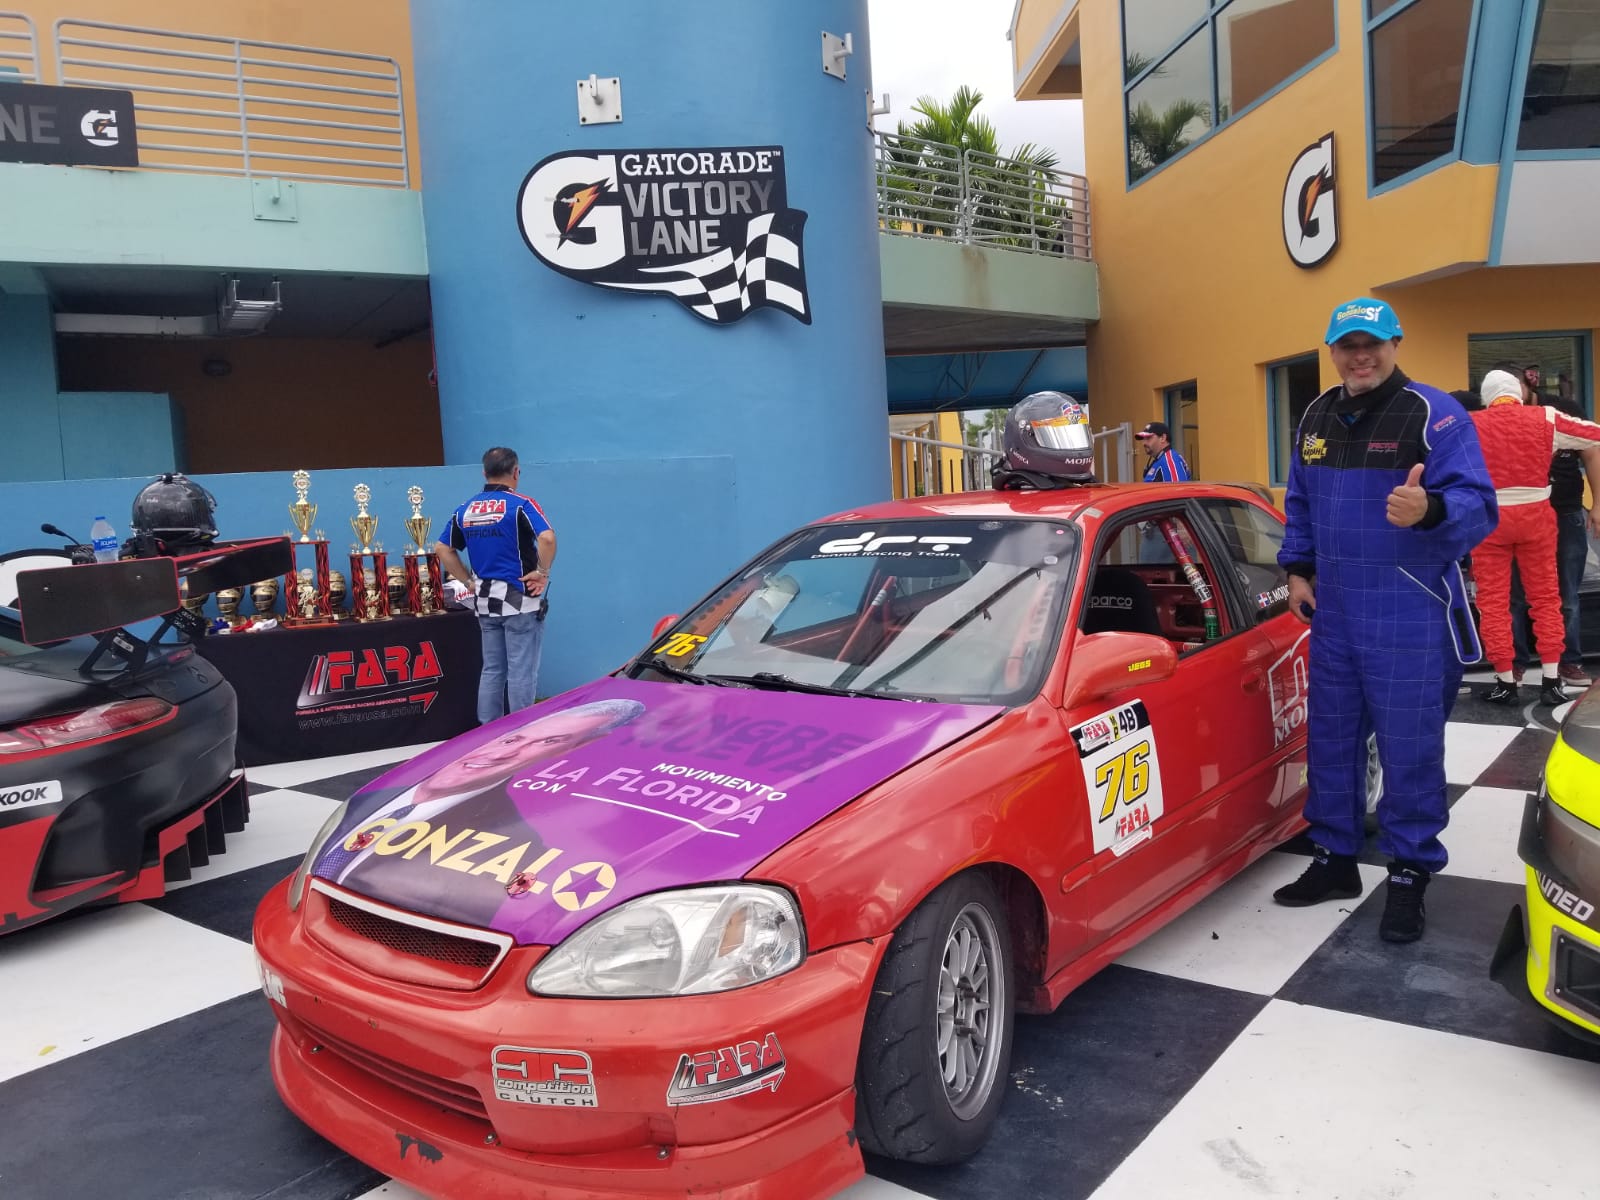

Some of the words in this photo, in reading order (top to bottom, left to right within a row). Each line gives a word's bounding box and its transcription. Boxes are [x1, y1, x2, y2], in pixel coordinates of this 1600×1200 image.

[623, 179, 775, 218] VICTORY
[630, 219, 722, 256] LANE
[471, 500, 506, 513] FARA
[653, 633, 708, 657] 76
[327, 641, 444, 692] FARA
[512, 778, 568, 794] CON
[534, 760, 590, 783] LA
[652, 763, 787, 801] MOVIMIENTO
[1095, 740, 1150, 824] 76
[1119, 803, 1150, 838] FARA
[1537, 870, 1595, 921] UNED
[693, 1031, 786, 1086] FARA
[500, 1093, 594, 1106] CLUTCH
